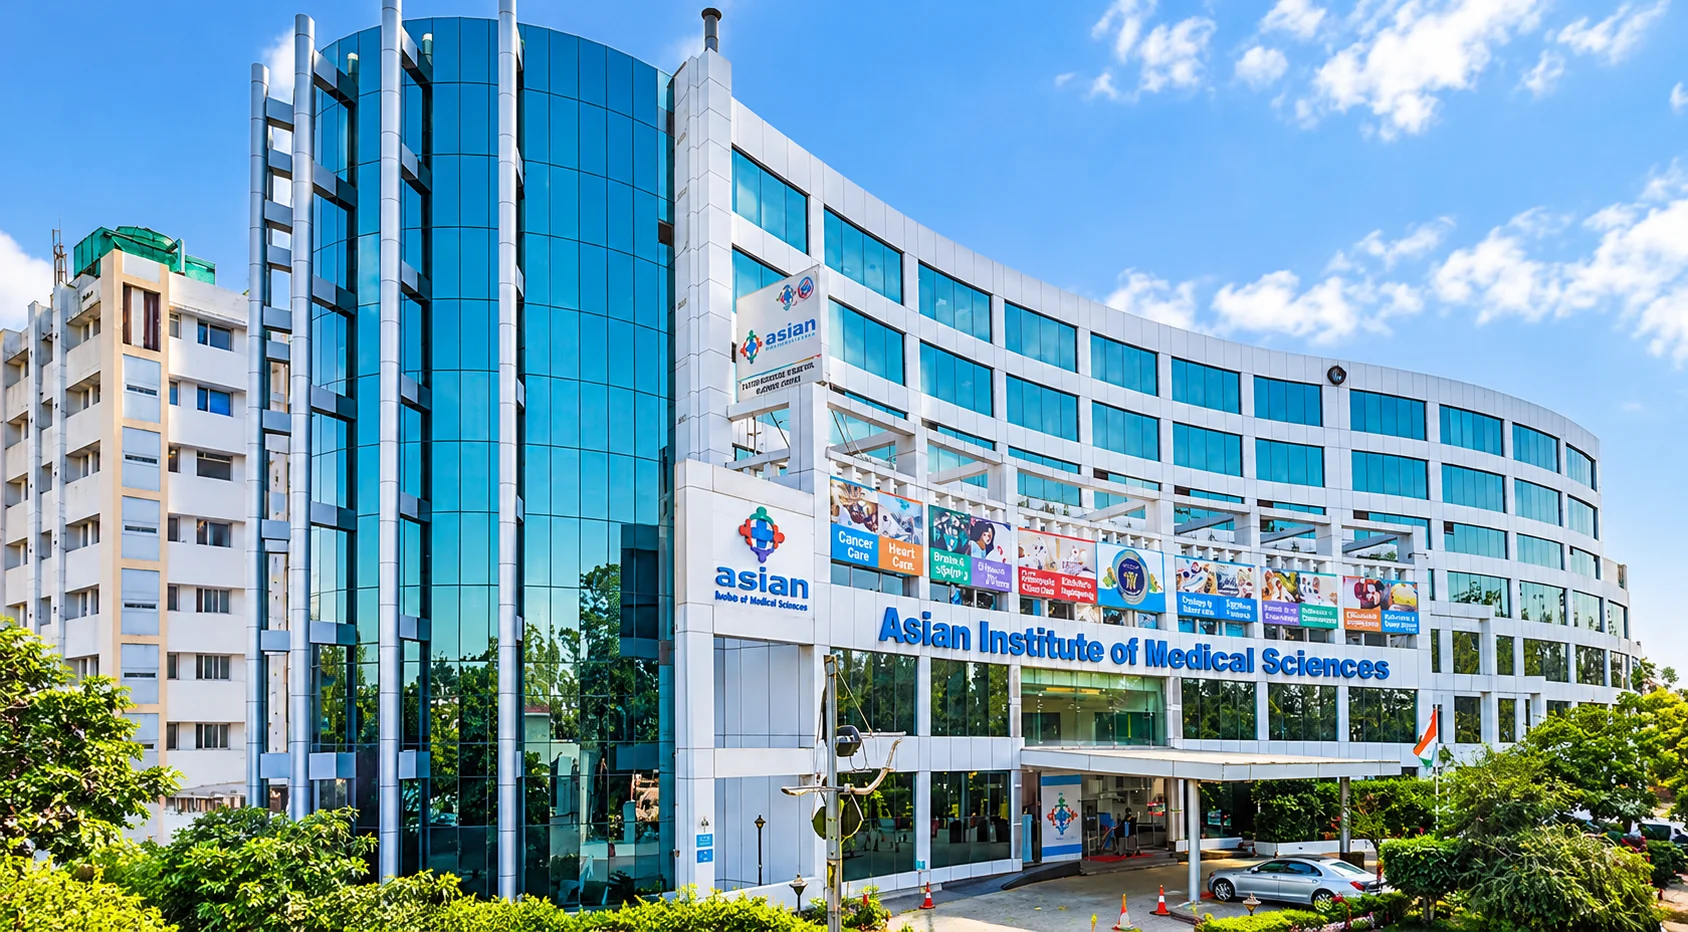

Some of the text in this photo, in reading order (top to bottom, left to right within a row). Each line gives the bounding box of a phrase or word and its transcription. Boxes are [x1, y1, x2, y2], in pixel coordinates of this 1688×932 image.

[765, 318, 816, 346] asian
[838, 530, 874, 550] Cancer
[888, 542, 915, 559] Heart
[847, 547, 870, 562] Care
[715, 566, 809, 599] asian
[878, 606, 1390, 681] Asian Institute of Medical Sciences
